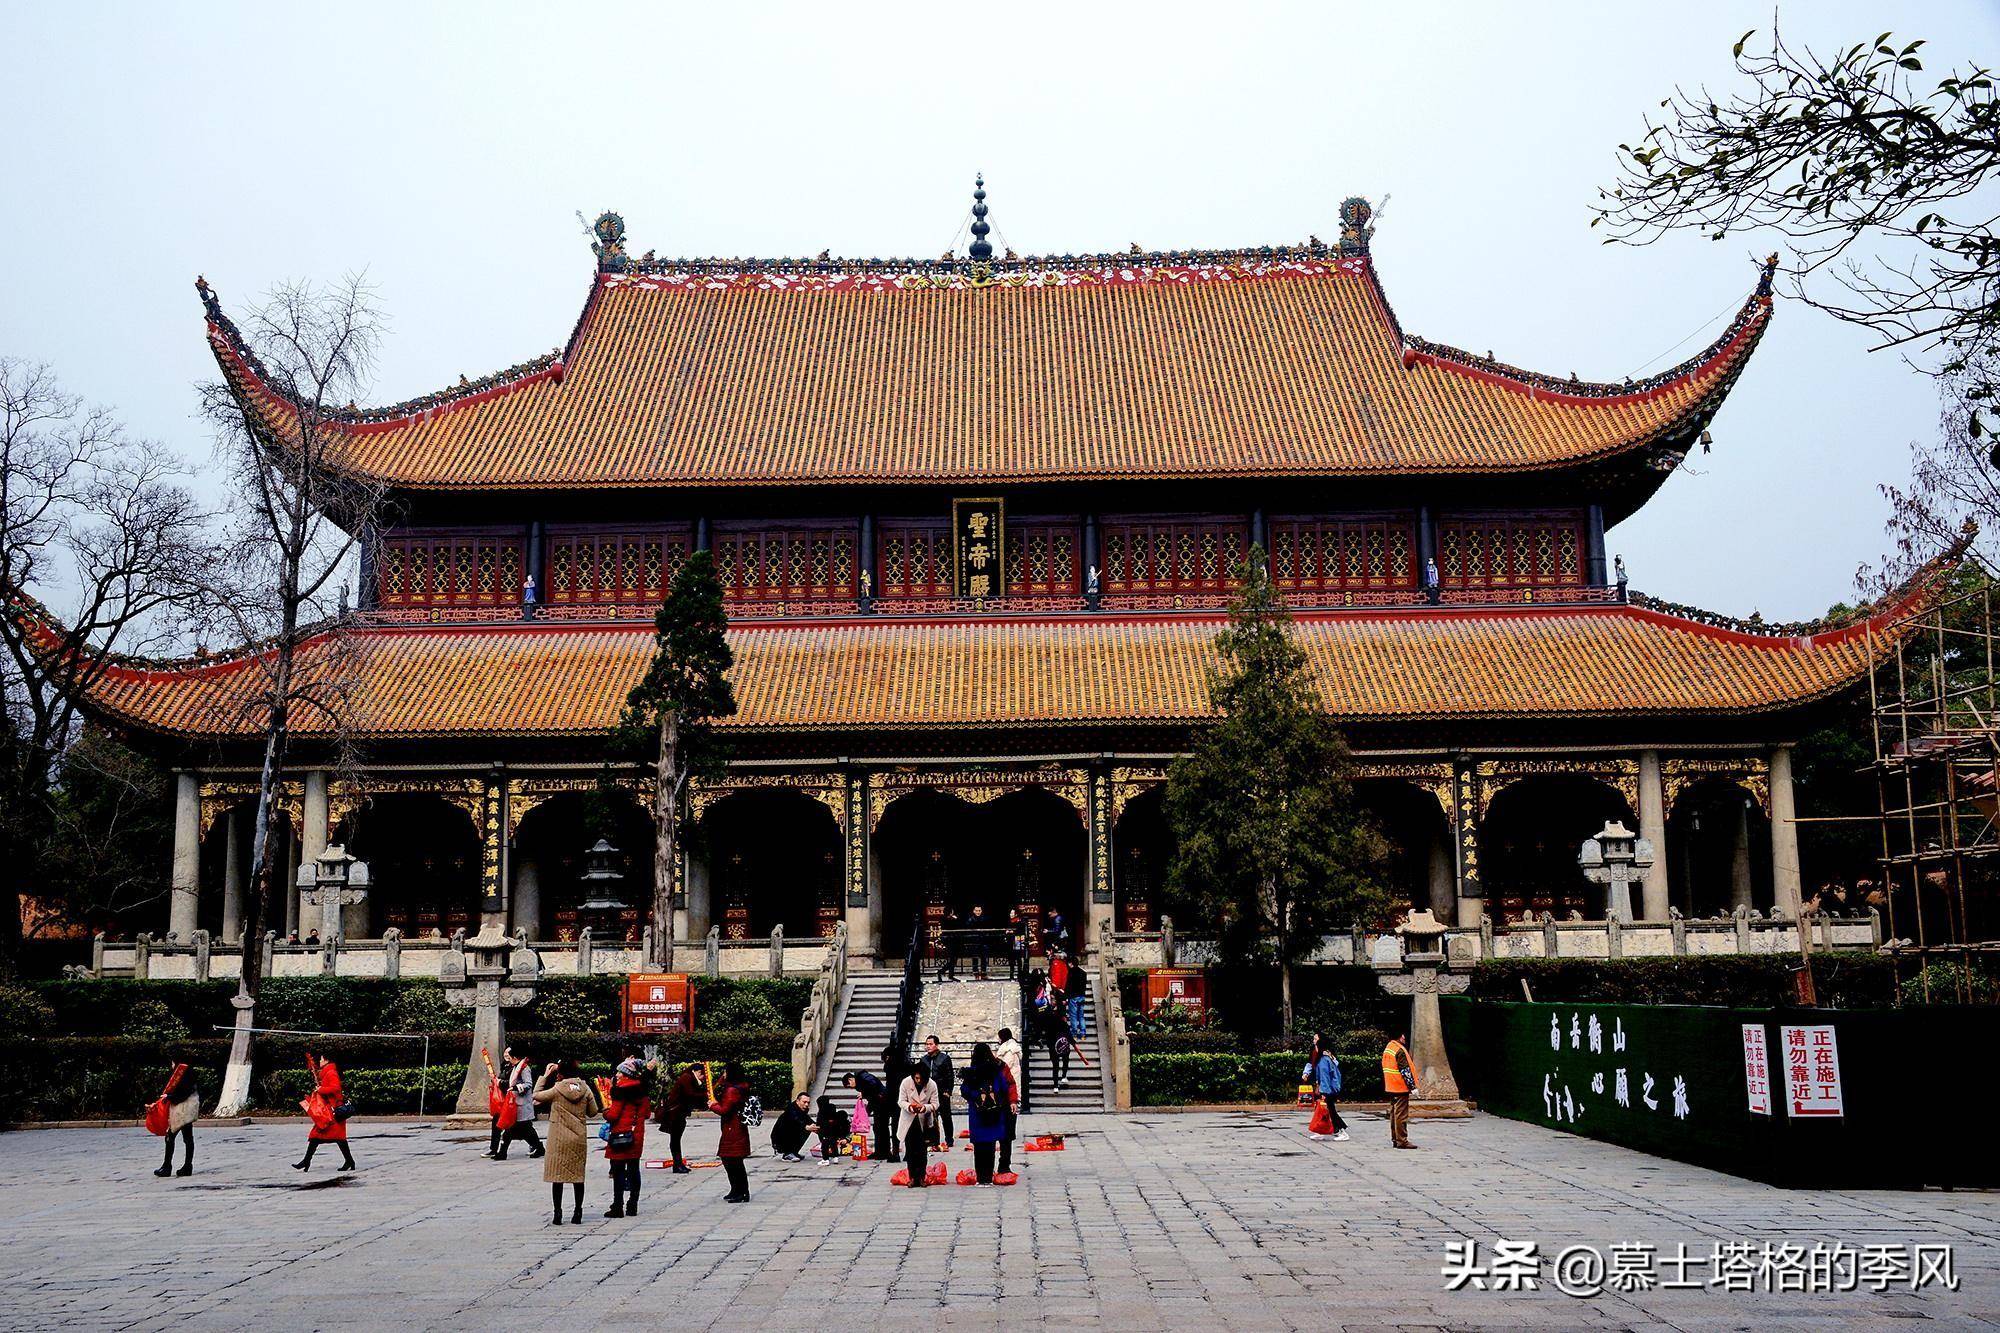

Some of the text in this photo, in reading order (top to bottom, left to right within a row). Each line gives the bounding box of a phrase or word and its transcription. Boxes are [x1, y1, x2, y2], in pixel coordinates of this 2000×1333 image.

[968, 512, 991, 597] 聖帝殿
[1550, 1012, 1626, 1054] 南岳衡山
[1744, 1029, 1757, 1095] 请勿靠近
[1754, 1030, 1767, 1095] 正在施工
[1787, 1029, 1811, 1100] 请勿靠近
[1812, 1030, 1837, 1100] 正在施工
